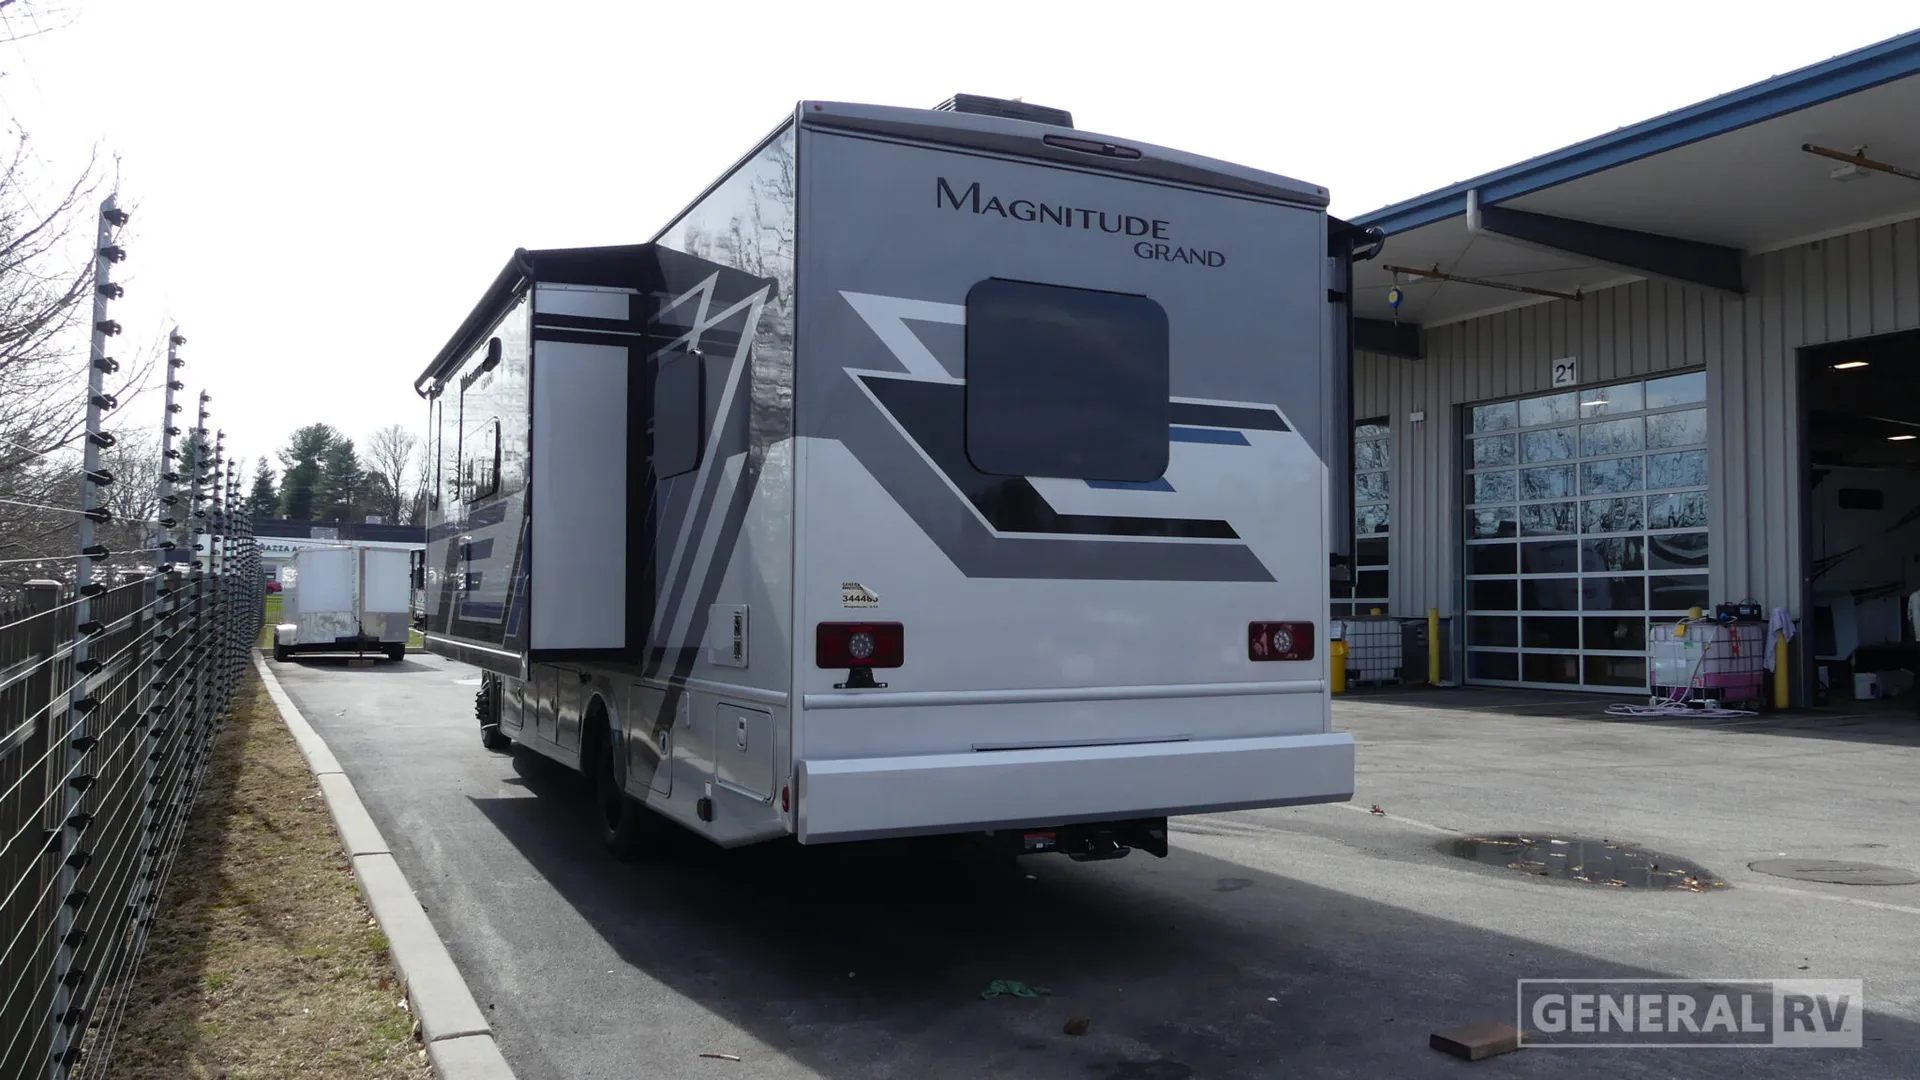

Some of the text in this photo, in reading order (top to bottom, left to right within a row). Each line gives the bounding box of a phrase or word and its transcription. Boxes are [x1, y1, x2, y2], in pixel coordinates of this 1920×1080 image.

[937, 176, 1170, 240] MAGNITUDE
[1133, 241, 1226, 268] GRAND
[1555, 362, 1575, 383] 21
